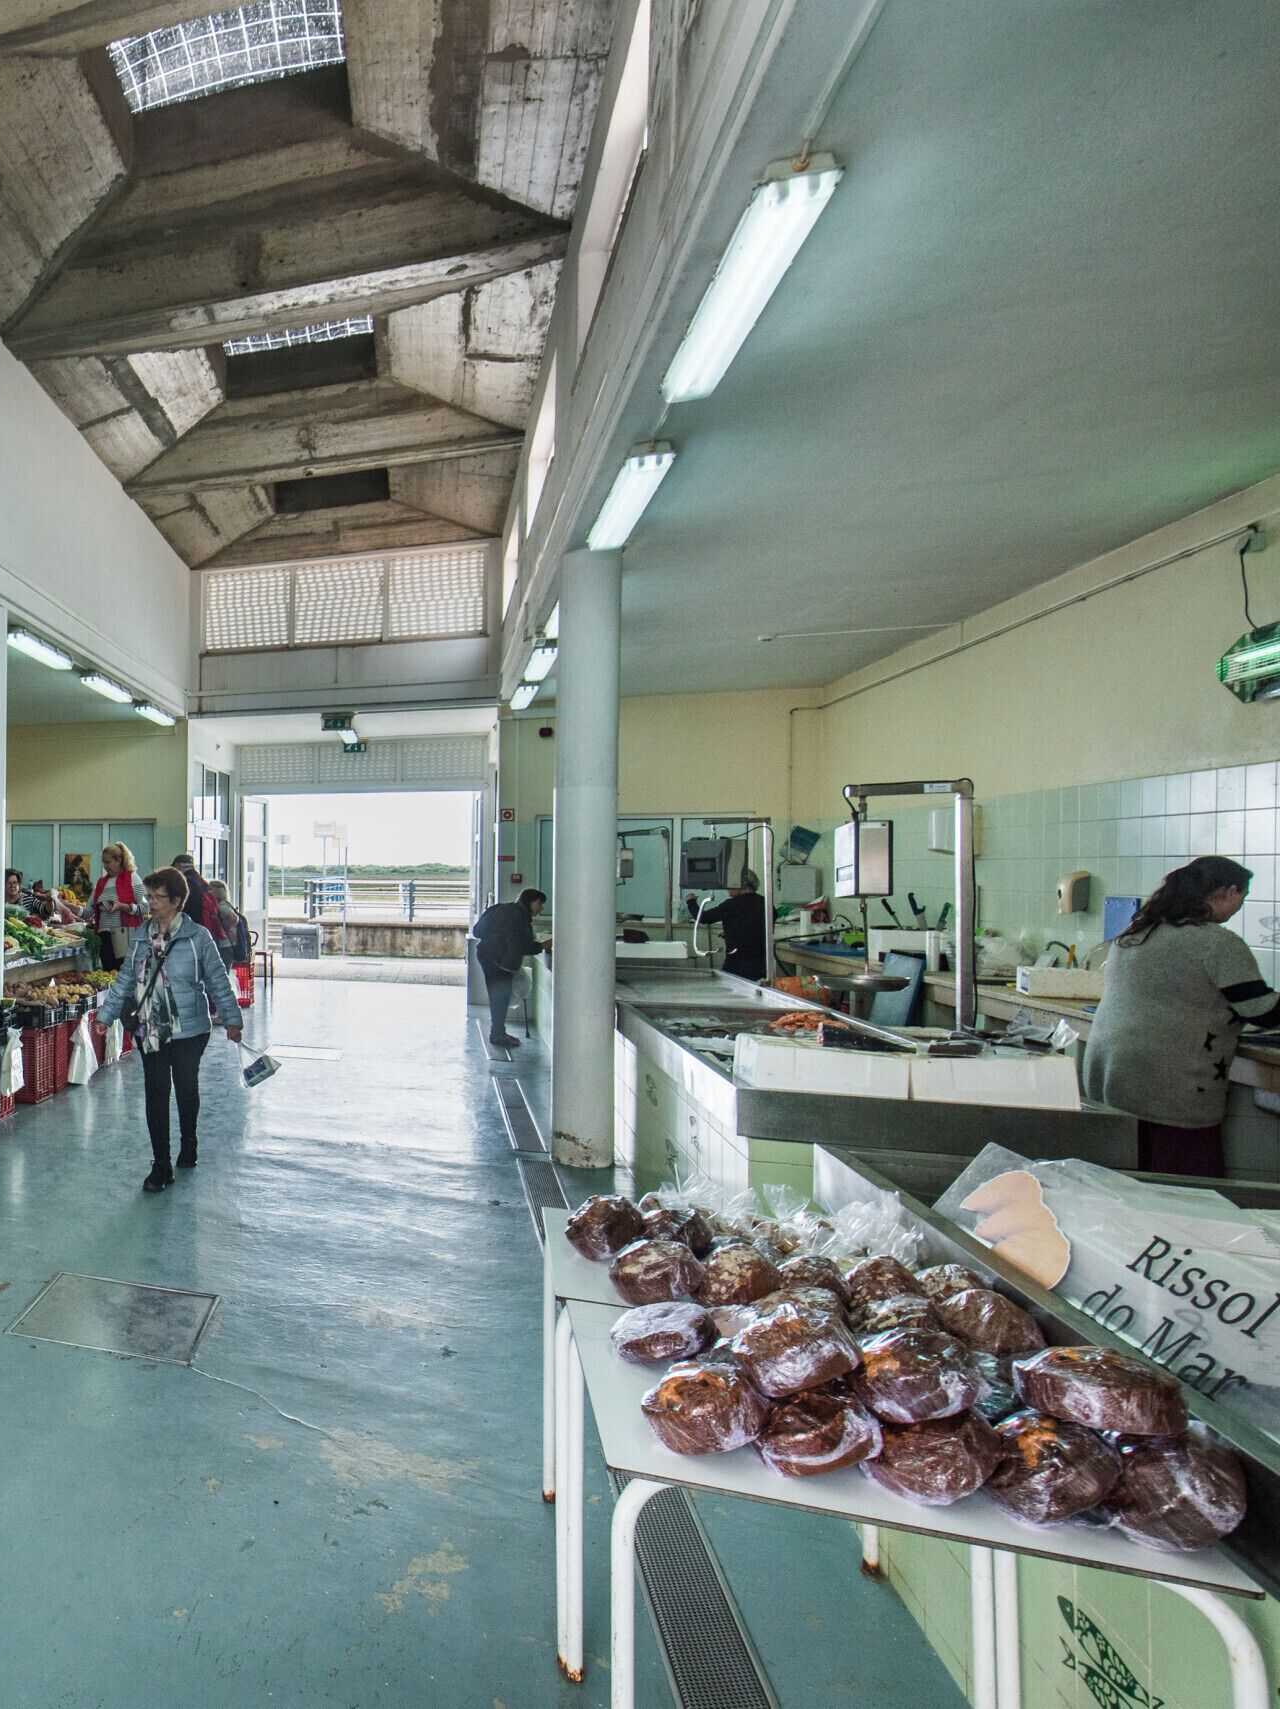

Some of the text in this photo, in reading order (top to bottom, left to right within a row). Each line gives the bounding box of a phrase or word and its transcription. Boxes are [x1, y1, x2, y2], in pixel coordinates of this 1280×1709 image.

[1126, 1235, 1280, 1338] Rissol
[1081, 1284, 1248, 1402] do Mar
